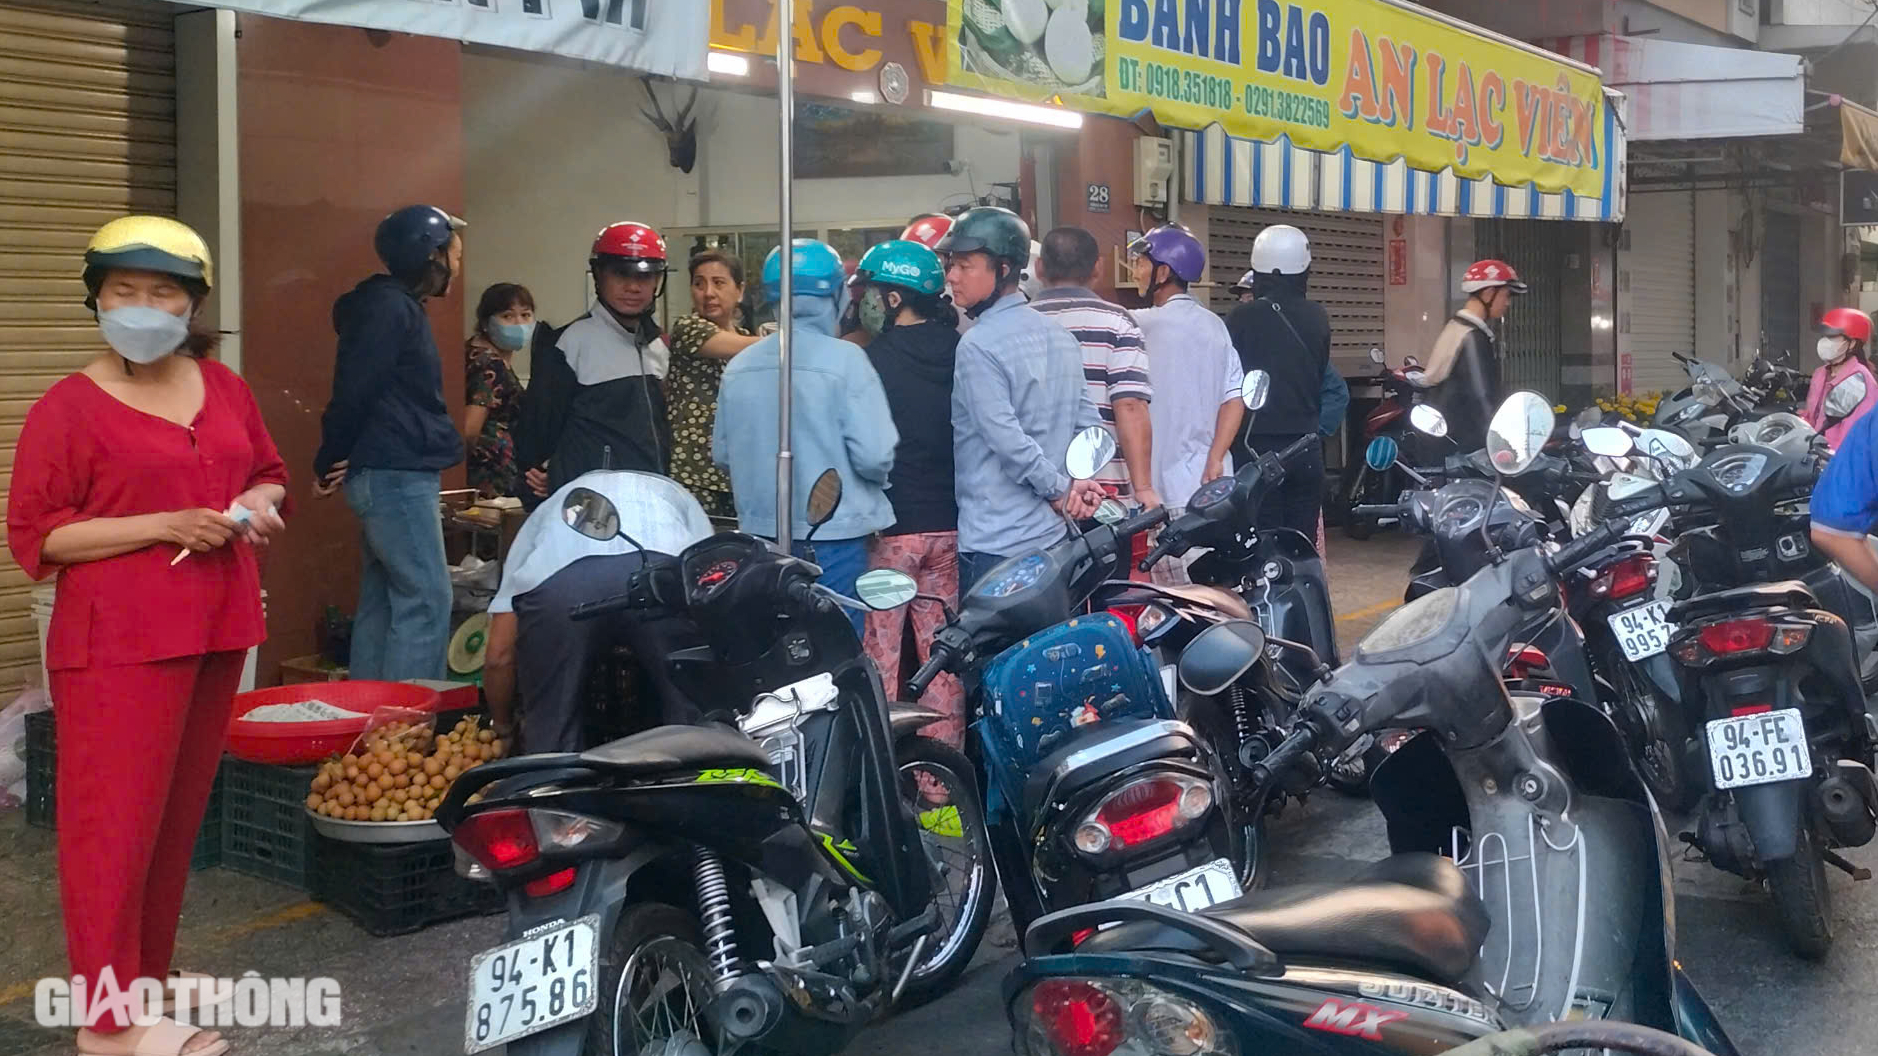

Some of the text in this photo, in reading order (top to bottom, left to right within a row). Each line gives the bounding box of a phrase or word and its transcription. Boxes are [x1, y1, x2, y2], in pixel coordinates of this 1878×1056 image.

[1256, 0, 1330, 86] BAO
[1146, 62, 1232, 111] 0918.351818
[1244, 84, 1330, 129] 0291.3822569
[1338, 27, 1599, 170] AN LẠC VIÊN
[1089, 185, 1109, 203] 28
[1625, 624, 1671, 656] 995.7
[1723, 716, 1790, 751] 94-FE
[1720, 744, 1803, 782] 036.91
[522, 918, 566, 938] HONDA
[490, 929, 575, 993] 94-K1
[476, 968, 588, 1041] 875.86
[1304, 998, 1402, 1041] MX
